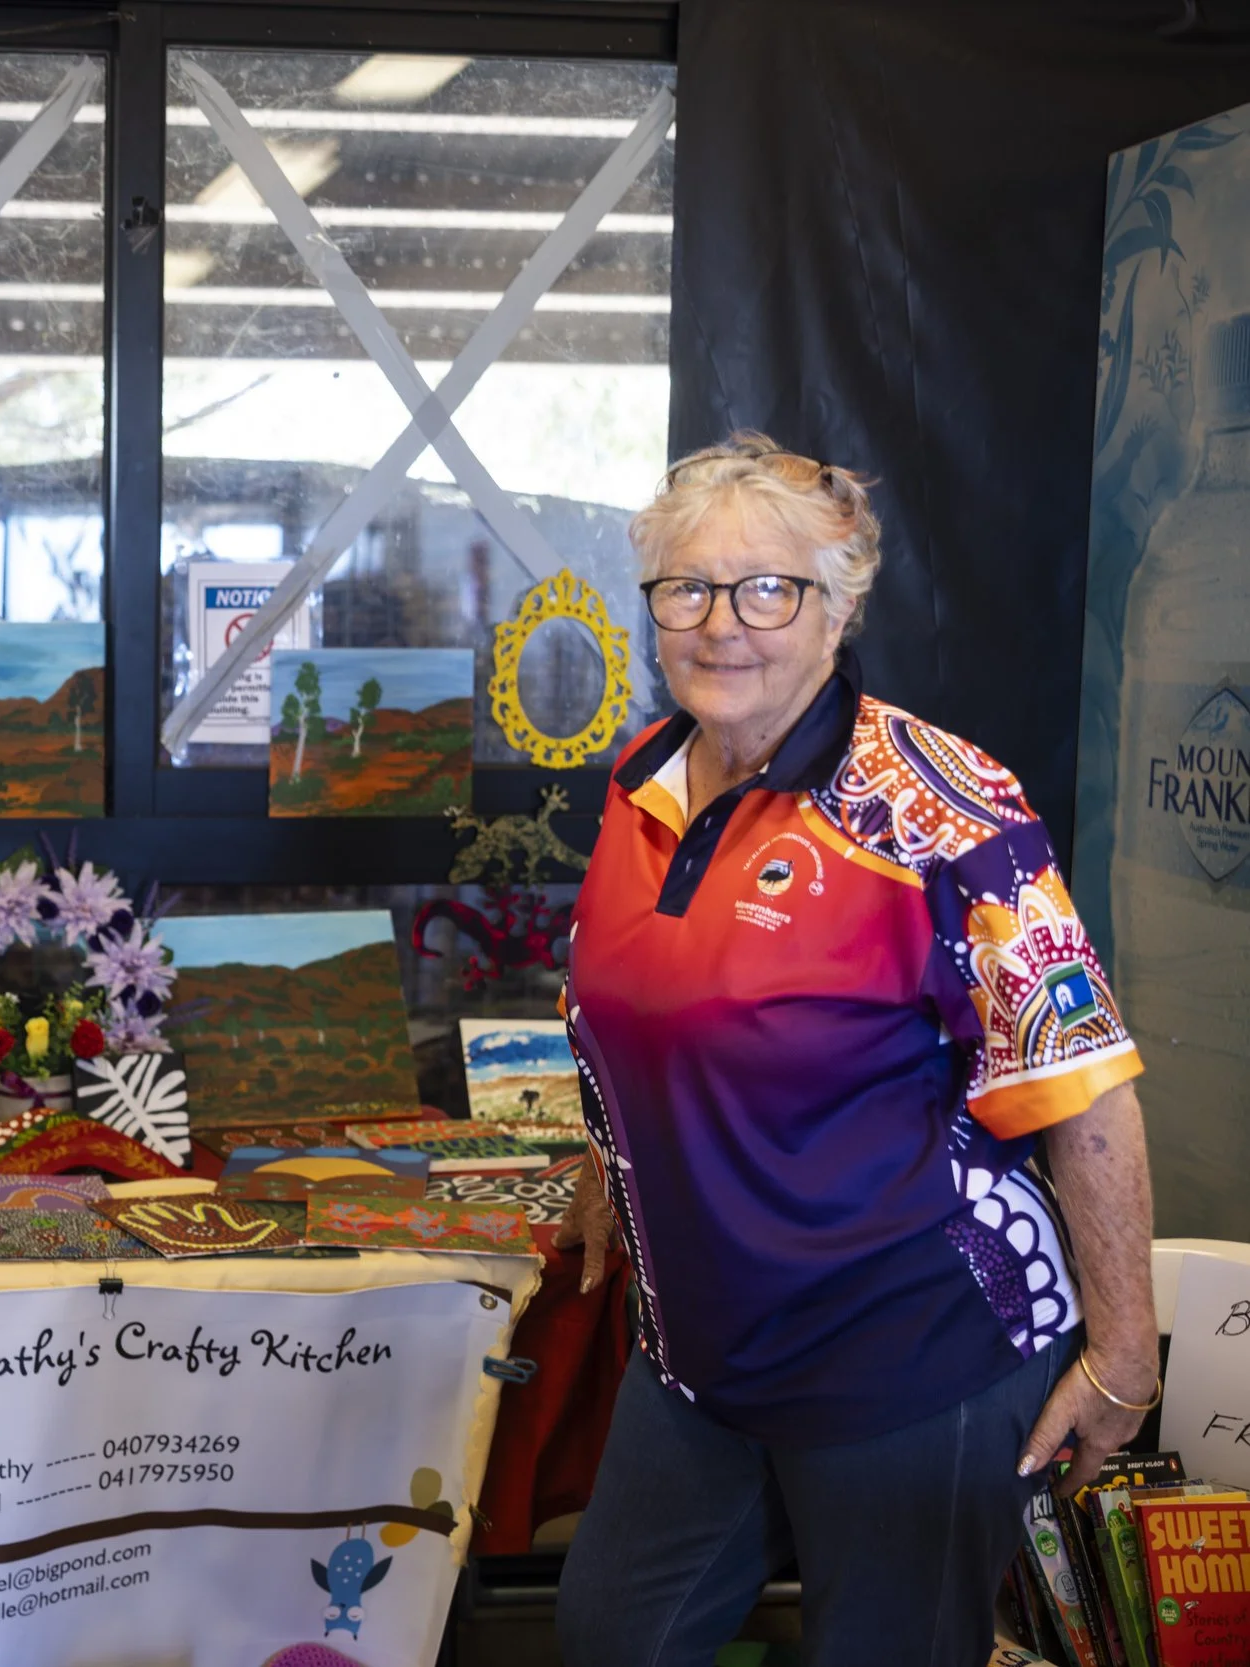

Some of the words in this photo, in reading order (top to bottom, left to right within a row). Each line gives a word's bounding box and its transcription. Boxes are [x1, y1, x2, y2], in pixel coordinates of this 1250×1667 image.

[216, 589, 272, 607] NOTIC
[1148, 758, 1250, 824] FRANK
[115, 1321, 241, 1377] Crafty
[250, 1327, 391, 1373] Kitchen
[103, 1434, 240, 1459] 0407934269
[98, 1463, 234, 1490] 0417975950
